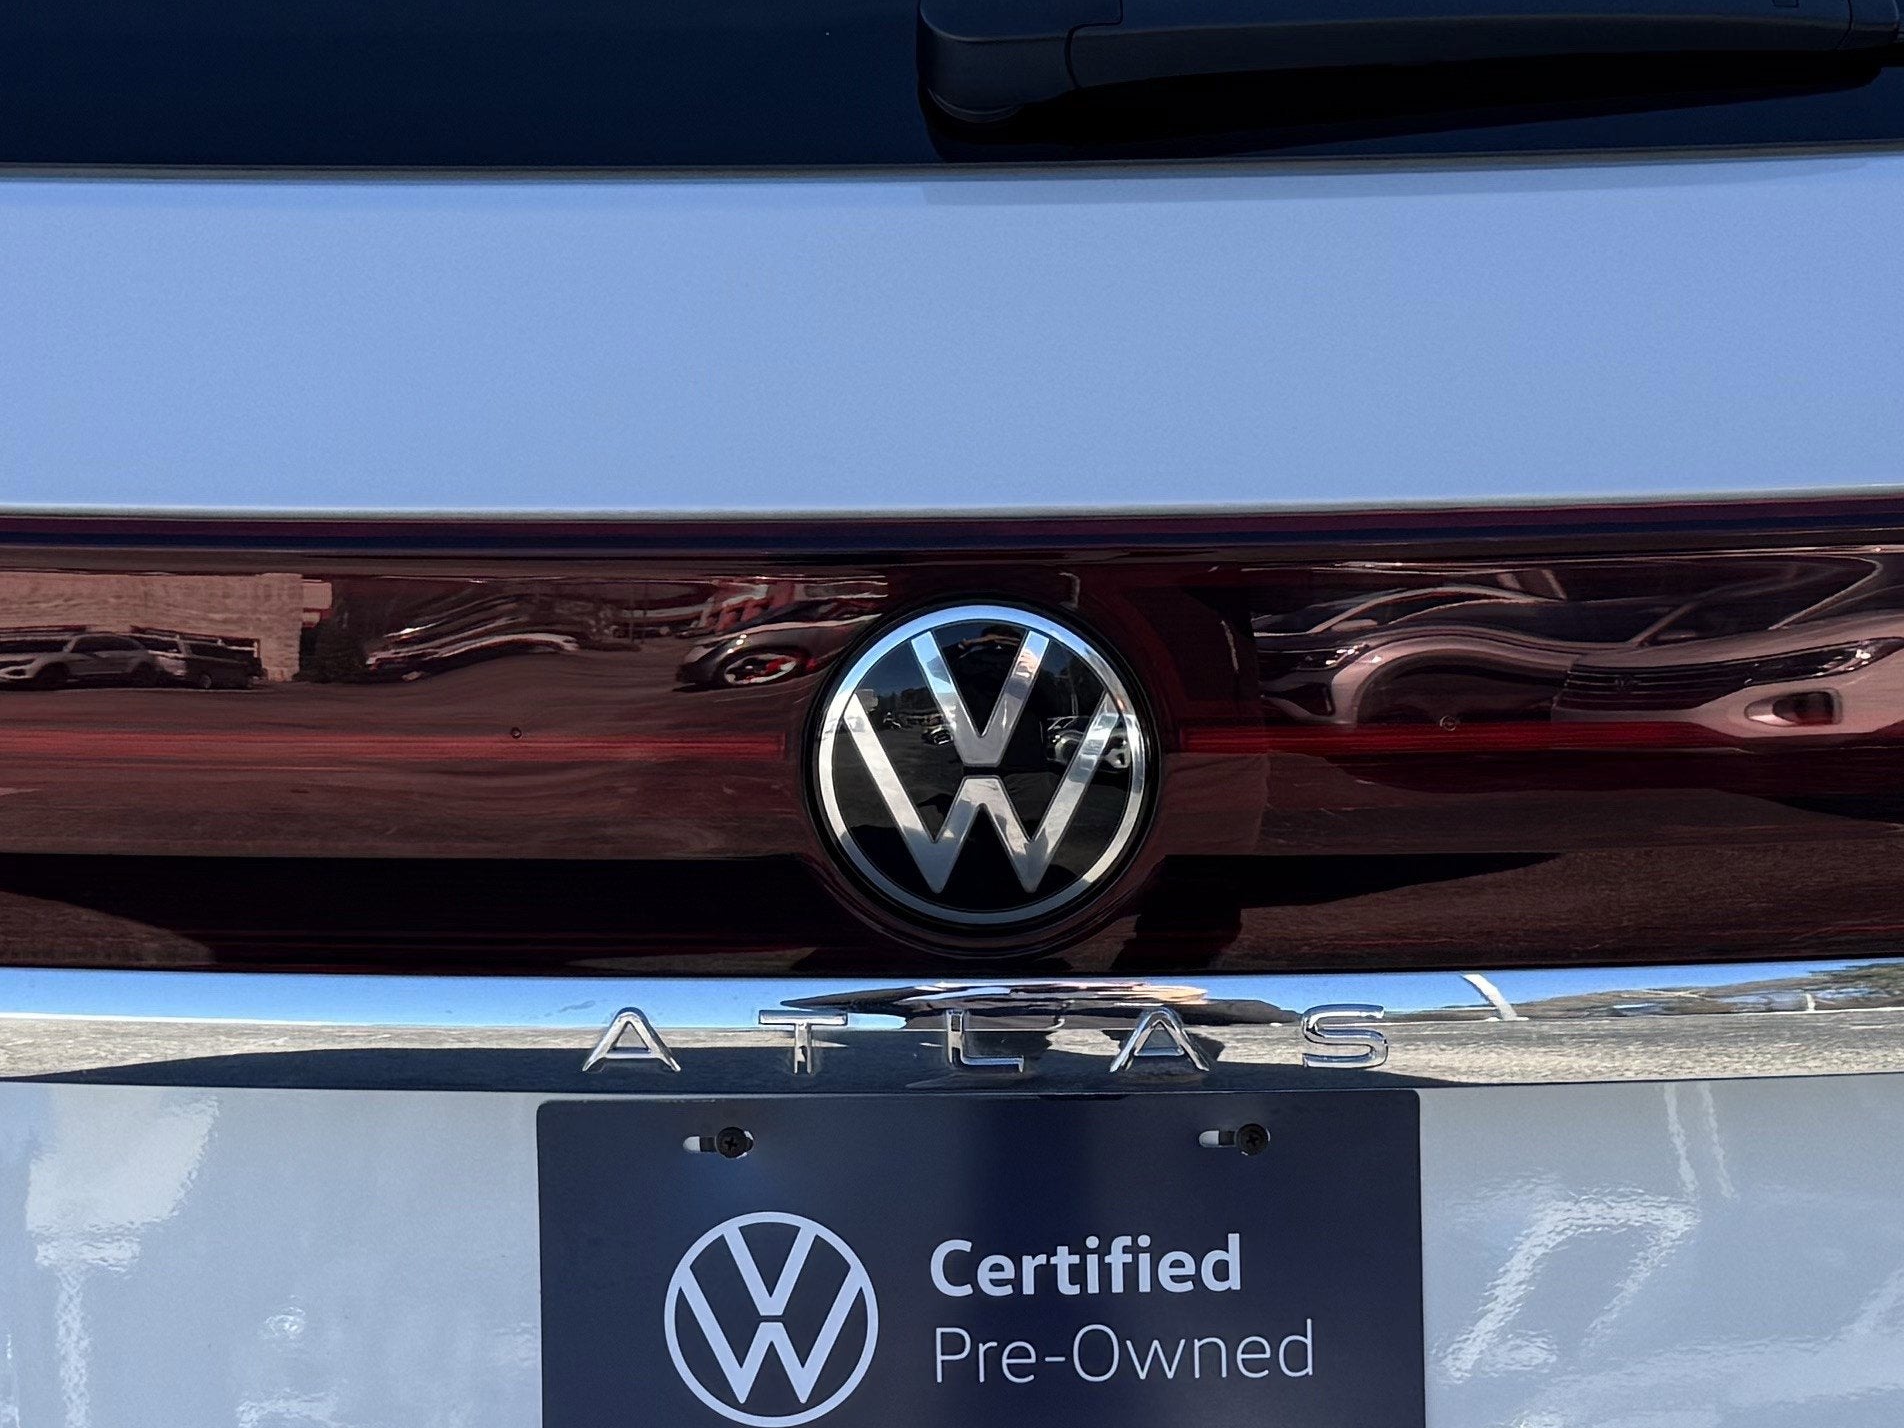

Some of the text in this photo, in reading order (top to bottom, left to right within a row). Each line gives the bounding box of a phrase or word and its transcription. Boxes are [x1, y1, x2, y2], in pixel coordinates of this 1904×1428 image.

[581, 1003, 1389, 1075] ATLAS
[929, 1232, 1243, 1299] Certified
[934, 1318, 1315, 1384] Pre-Owned
